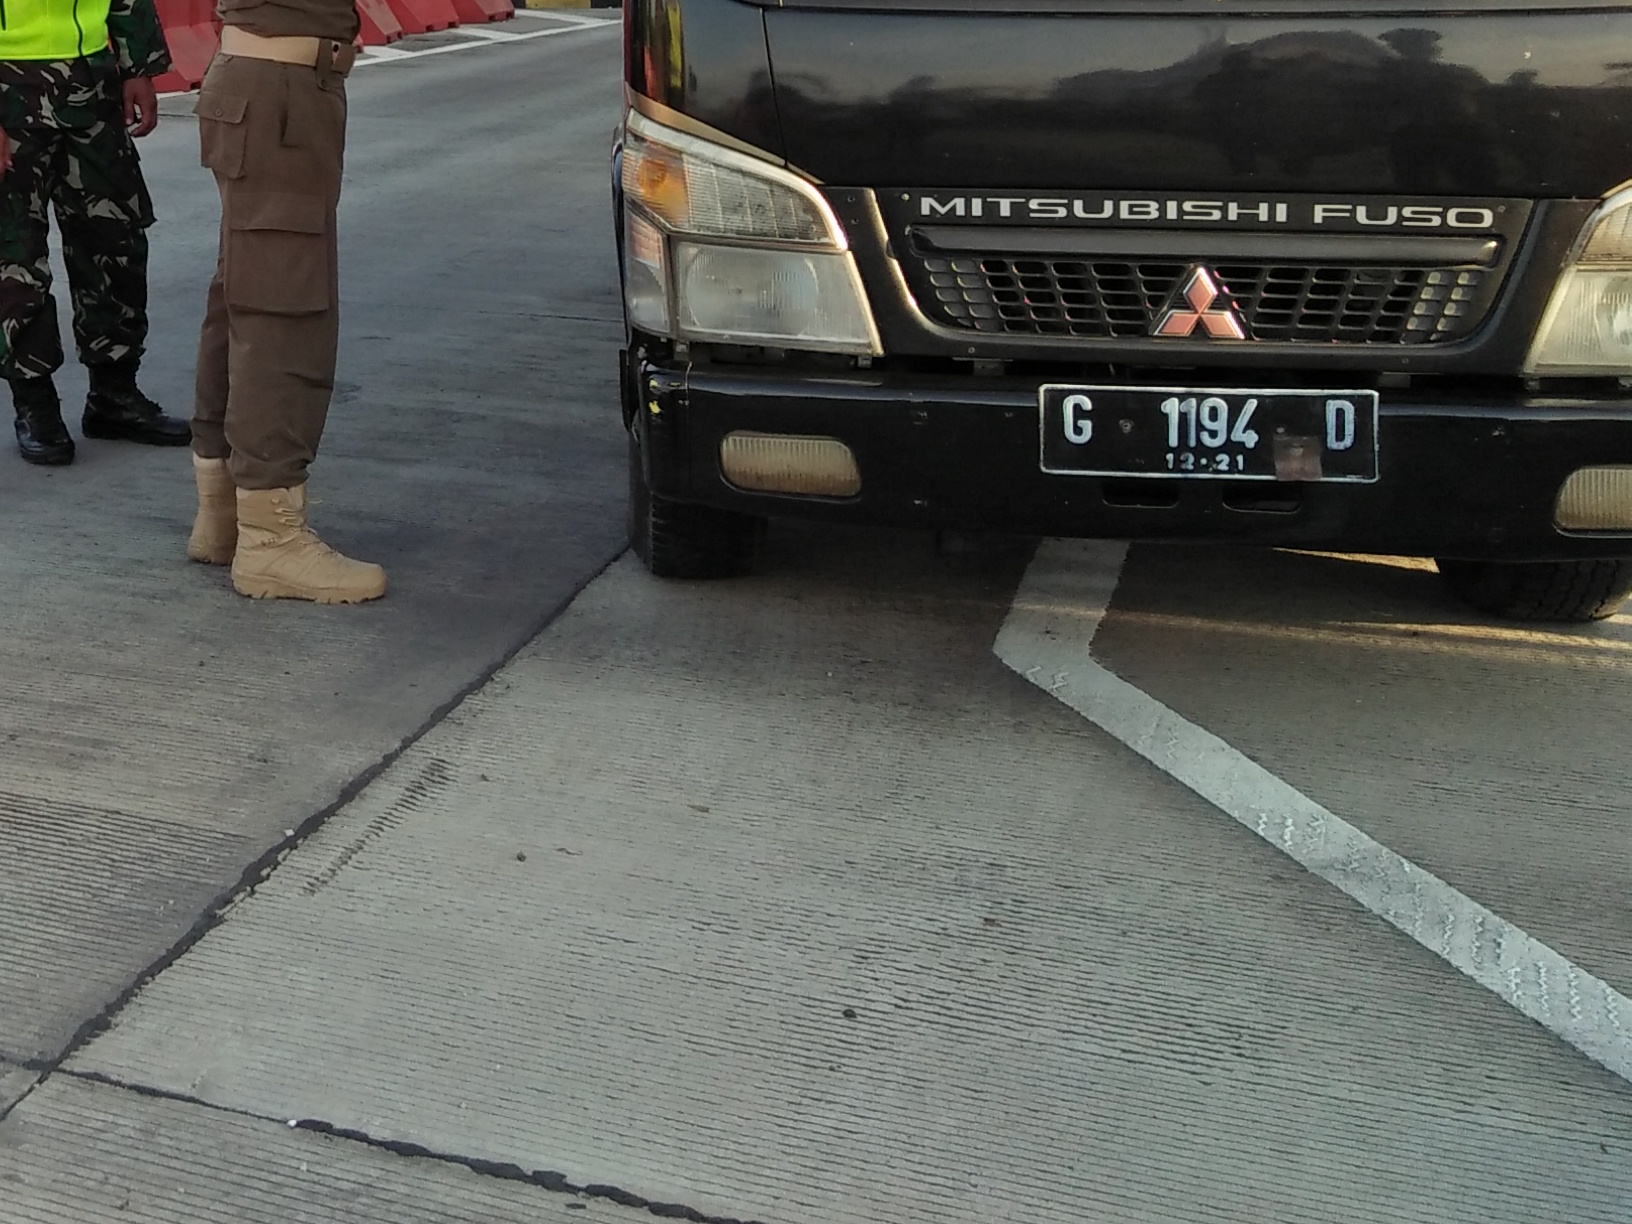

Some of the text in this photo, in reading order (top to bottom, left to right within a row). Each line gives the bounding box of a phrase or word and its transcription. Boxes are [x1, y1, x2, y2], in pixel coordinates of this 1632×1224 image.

[920, 196, 1493, 229] MITSUBISHI FUSO
[1062, 394, 1356, 451] G 1194 D
